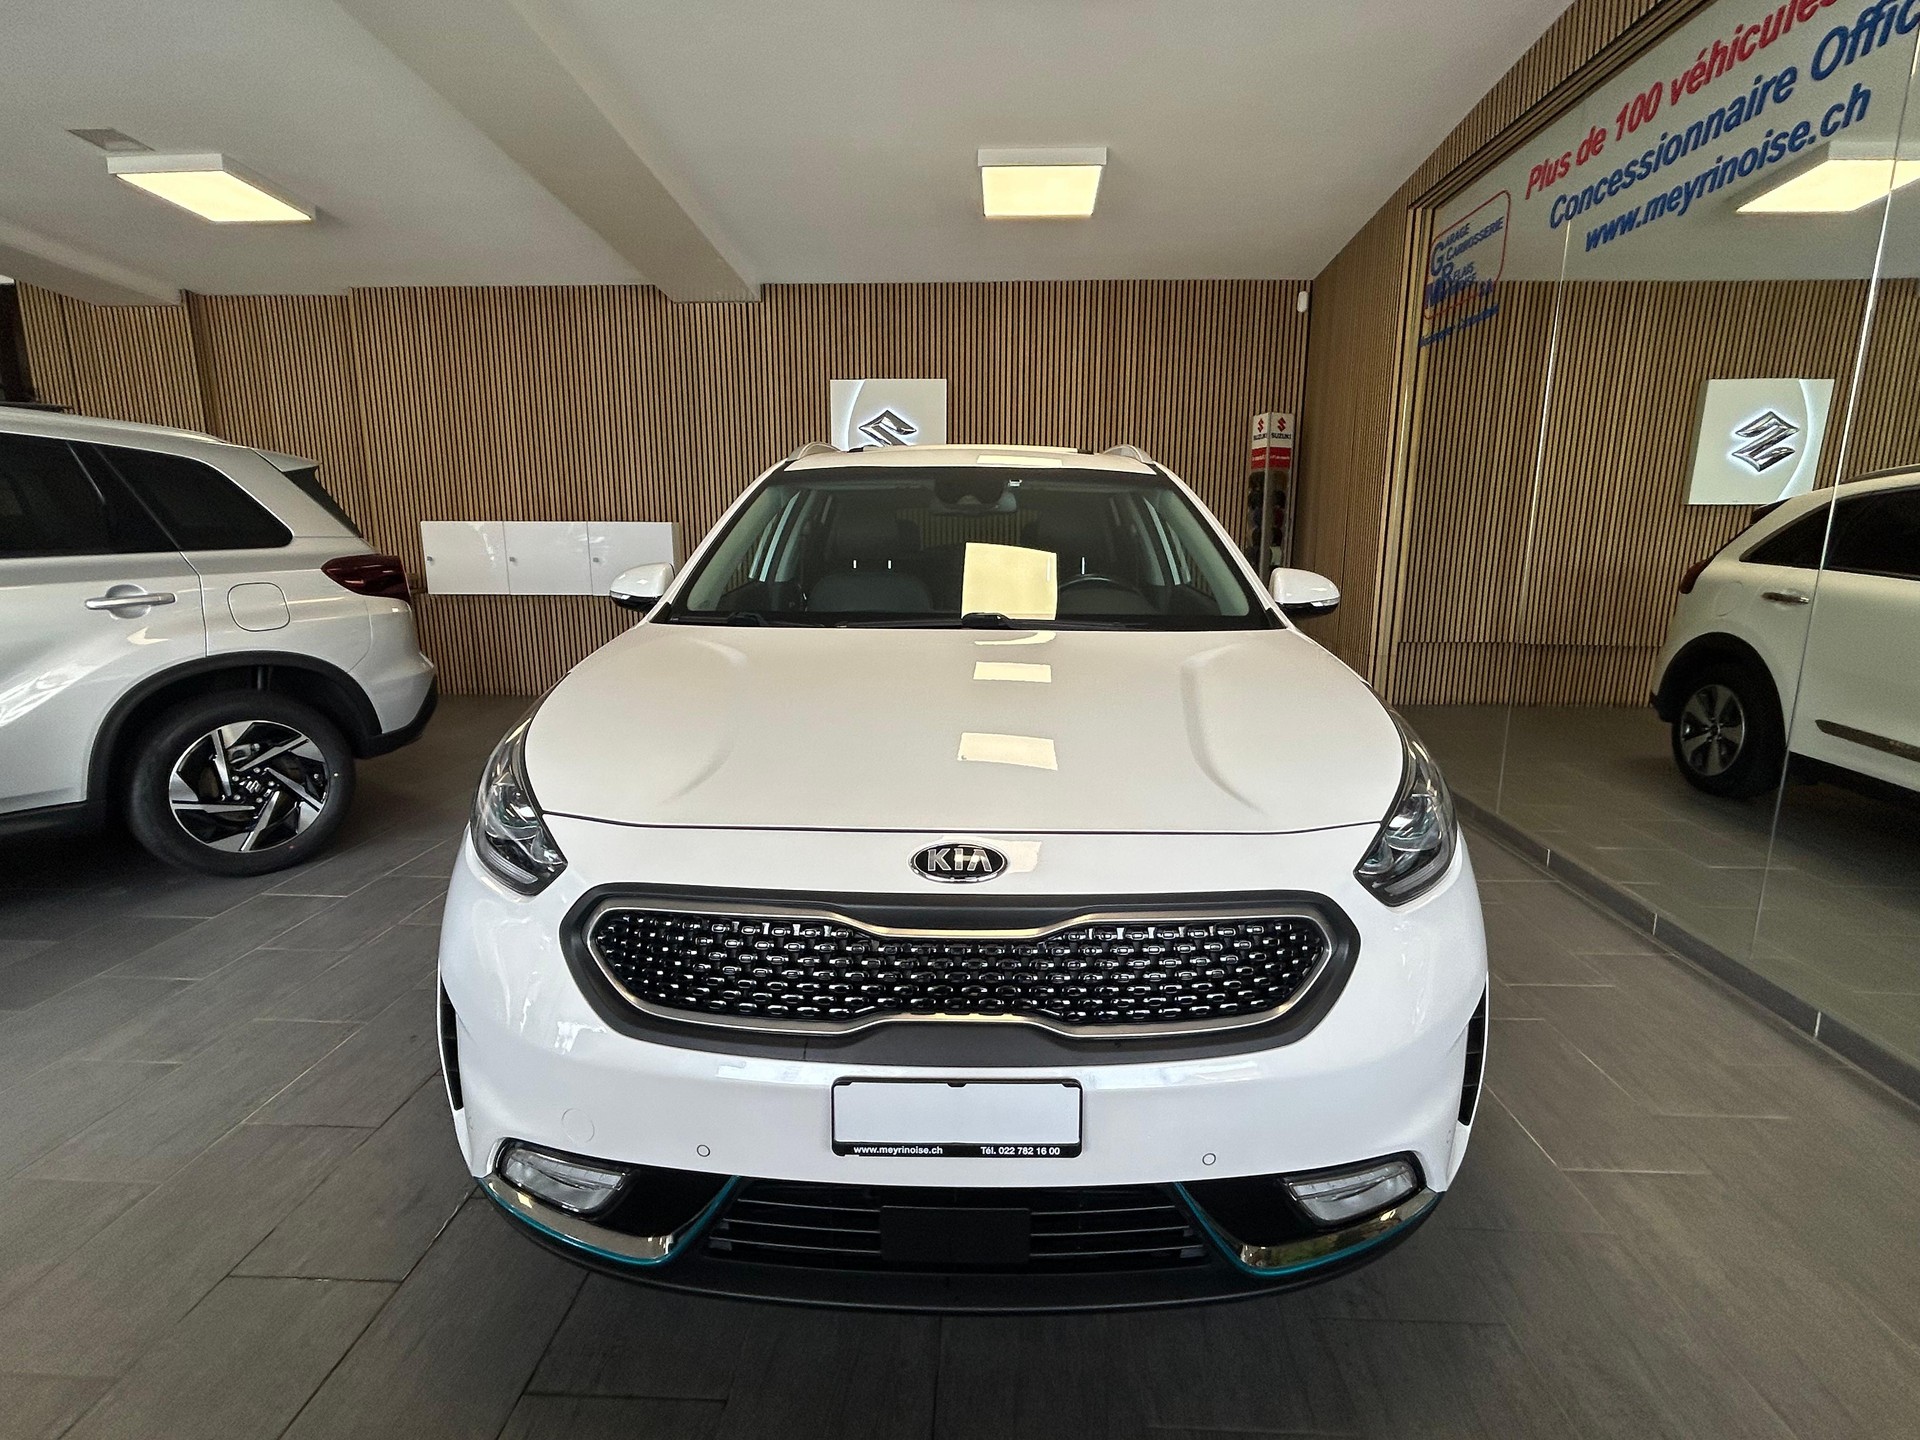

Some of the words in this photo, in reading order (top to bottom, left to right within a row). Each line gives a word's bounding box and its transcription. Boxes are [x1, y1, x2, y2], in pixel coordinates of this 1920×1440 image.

[1525, 150, 1570, 200] Plus
[1577, 126, 1608, 166] de
[1616, 81, 1664, 142] 100
[1550, 66, 1798, 230] Concessionnaire
[1585, 83, 1872, 252] www.meyrinoise.ch
[928, 848, 992, 872] KIA
[853, 1146, 943, 1156] www.meyrinoise.ch
[998, 1146, 1015, 1155] 022
[1017, 1146, 1034, 1155] 782
[1036, 1146, 1047, 1155] 16
[1049, 1146, 1060, 1155] 00
